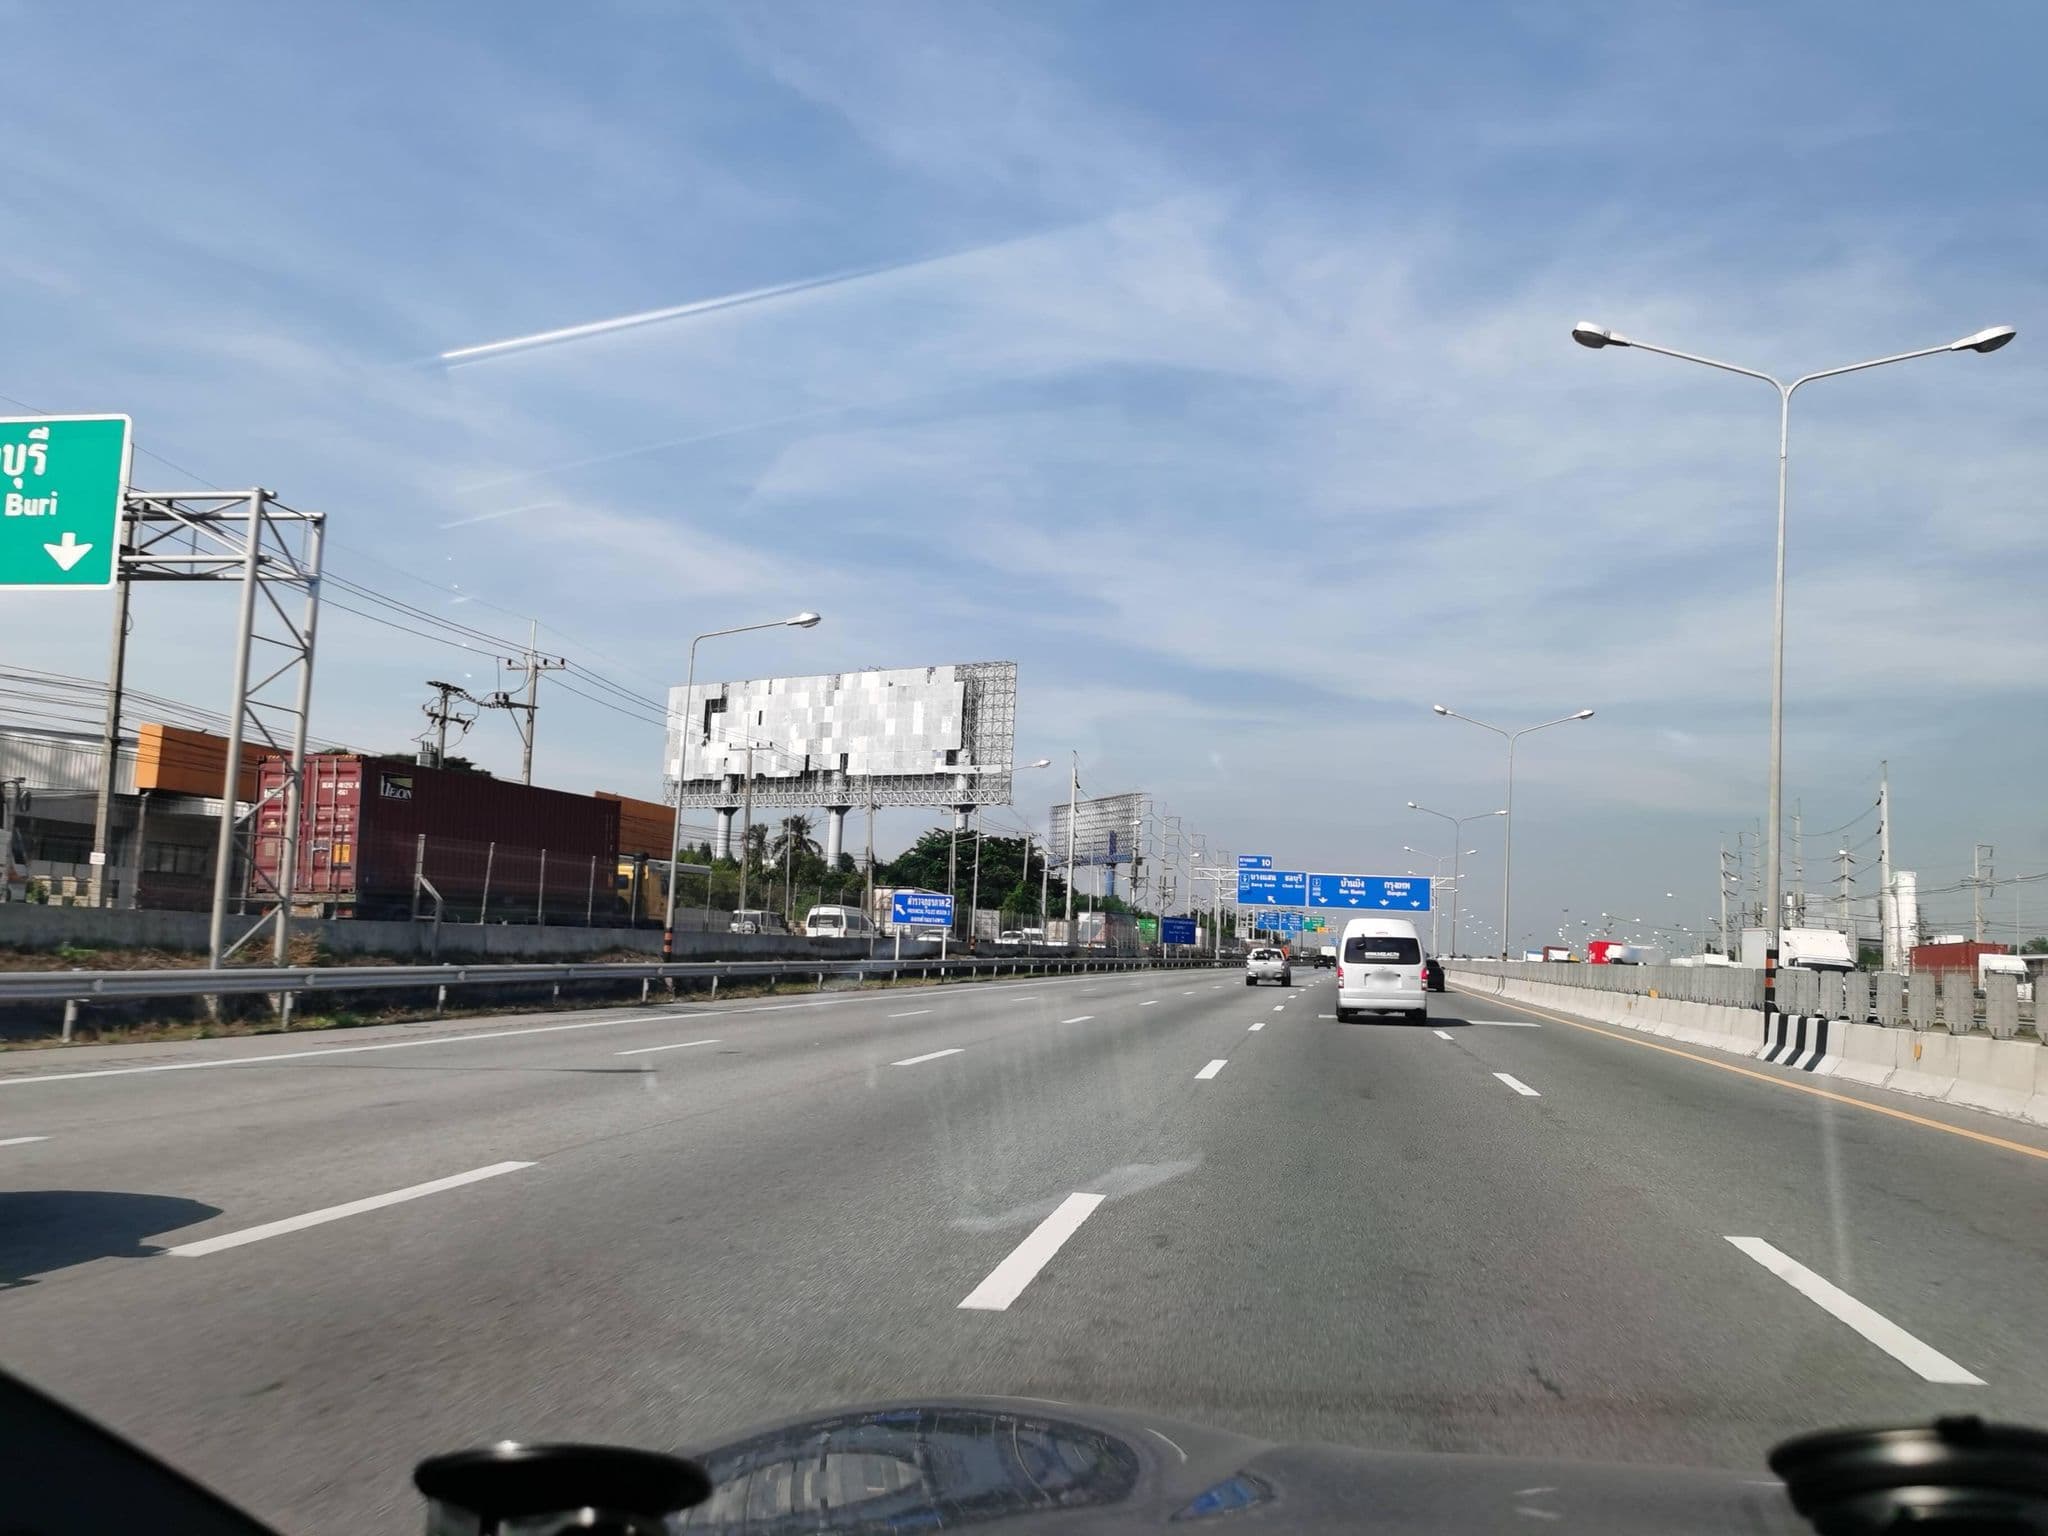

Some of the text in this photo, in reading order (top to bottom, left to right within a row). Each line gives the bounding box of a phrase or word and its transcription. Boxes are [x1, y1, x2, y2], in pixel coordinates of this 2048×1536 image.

[0, 426, 50, 489] บุรี
[5, 490, 58, 516] Buri
[1261, 858, 1271, 867] 10
